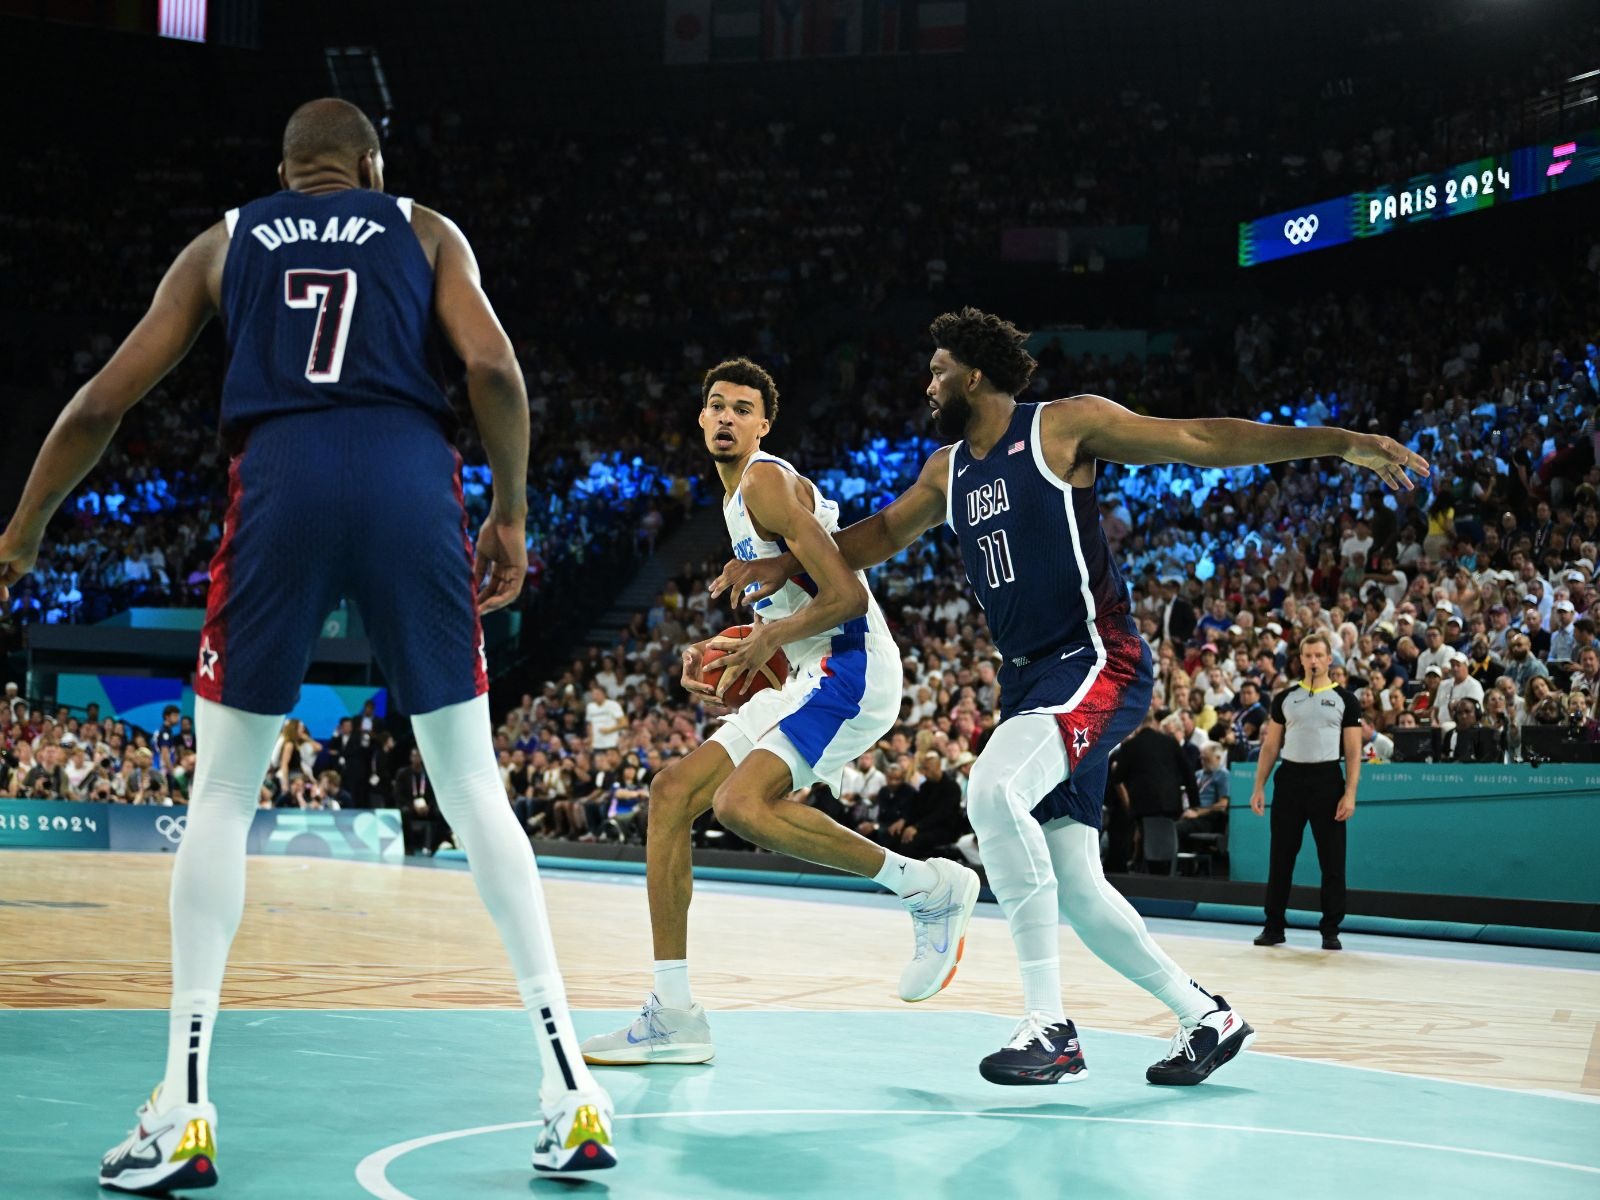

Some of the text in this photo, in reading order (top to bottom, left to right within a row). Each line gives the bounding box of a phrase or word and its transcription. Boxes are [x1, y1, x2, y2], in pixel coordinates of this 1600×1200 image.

[1369, 167, 1510, 224] PARIS 2024
[251, 216, 386, 251] DURANT
[284, 268, 358, 384] 7
[966, 478, 1010, 526] USA
[977, 529, 1015, 589] 11
[38, 815, 97, 832] 2024
